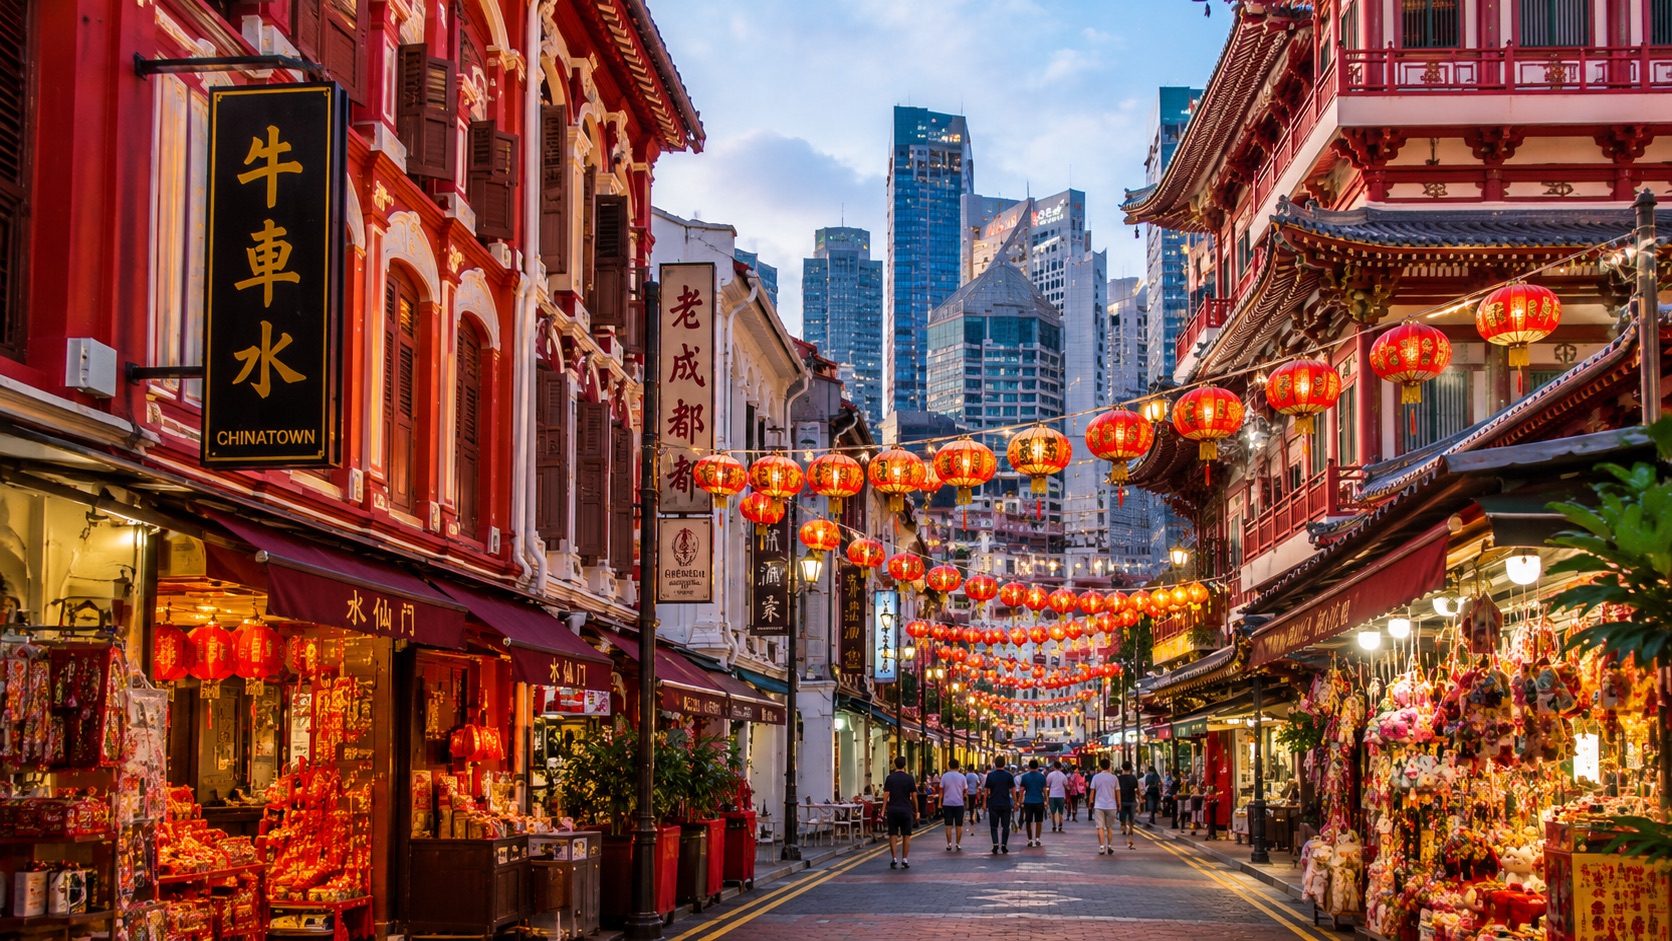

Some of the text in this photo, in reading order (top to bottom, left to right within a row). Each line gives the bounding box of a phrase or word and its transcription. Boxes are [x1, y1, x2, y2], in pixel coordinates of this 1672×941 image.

[231, 124, 307, 399] 牛車水
[216, 428, 316, 447] CHINATOWN
